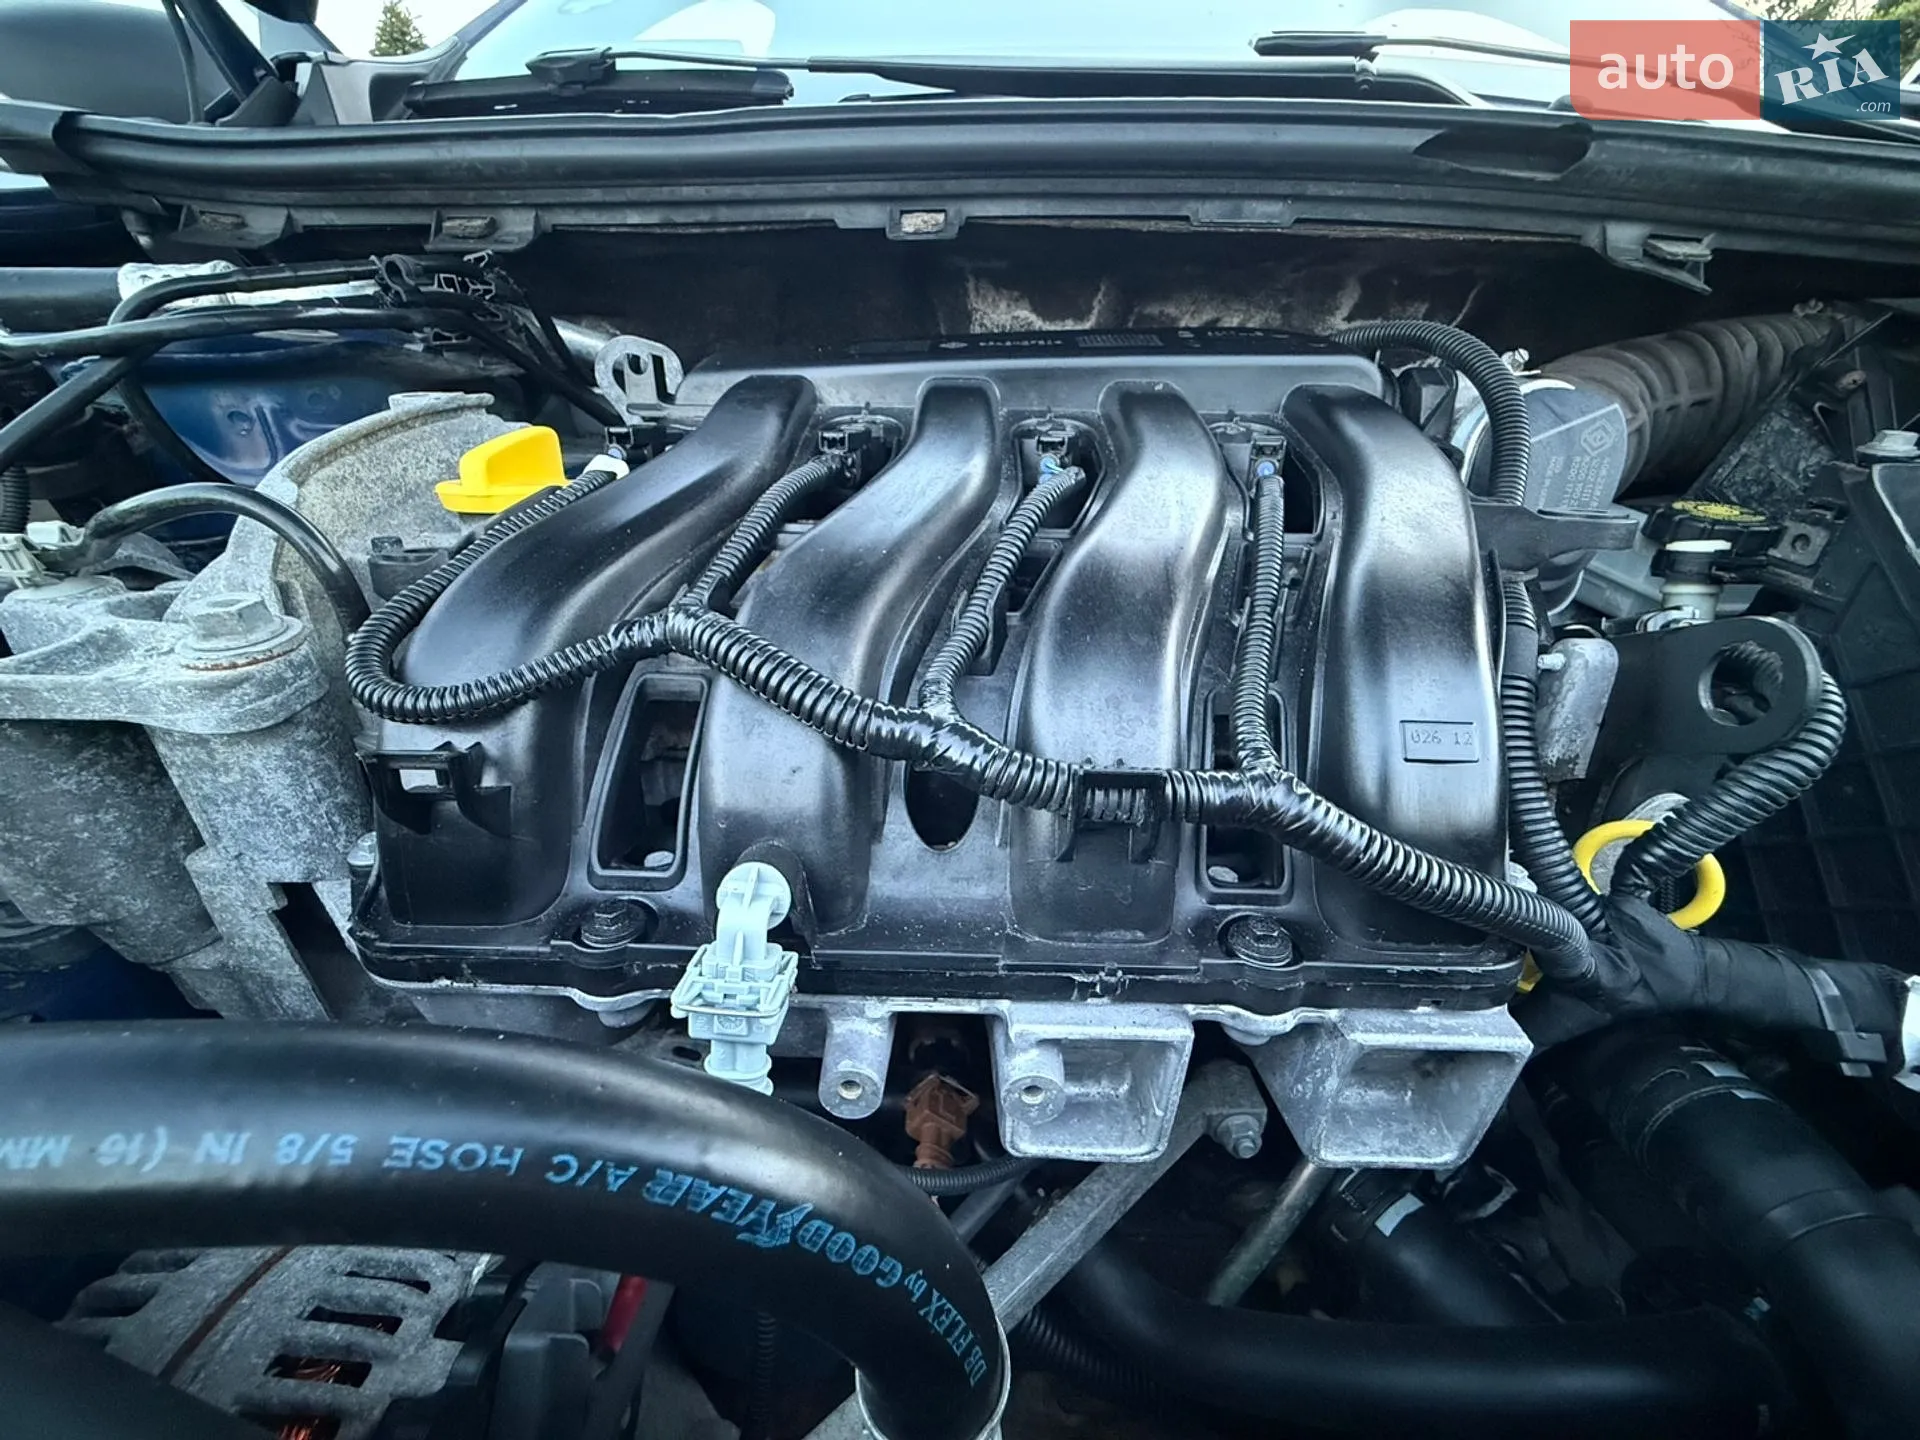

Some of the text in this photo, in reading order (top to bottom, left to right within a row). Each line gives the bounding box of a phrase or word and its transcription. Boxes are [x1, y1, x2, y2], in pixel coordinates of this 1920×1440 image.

[95, 1125, 169, 1173] (16
[194, 1132, 252, 1166] IN
[275, 1132, 359, 1167] 5/8
[382, 1134, 525, 1177] HOSE
[545, 1152, 640, 1193] A/C
[904, 1268, 928, 1303] by
[918, 1287, 974, 1357] FLEX
[964, 1344, 987, 1387] DB
